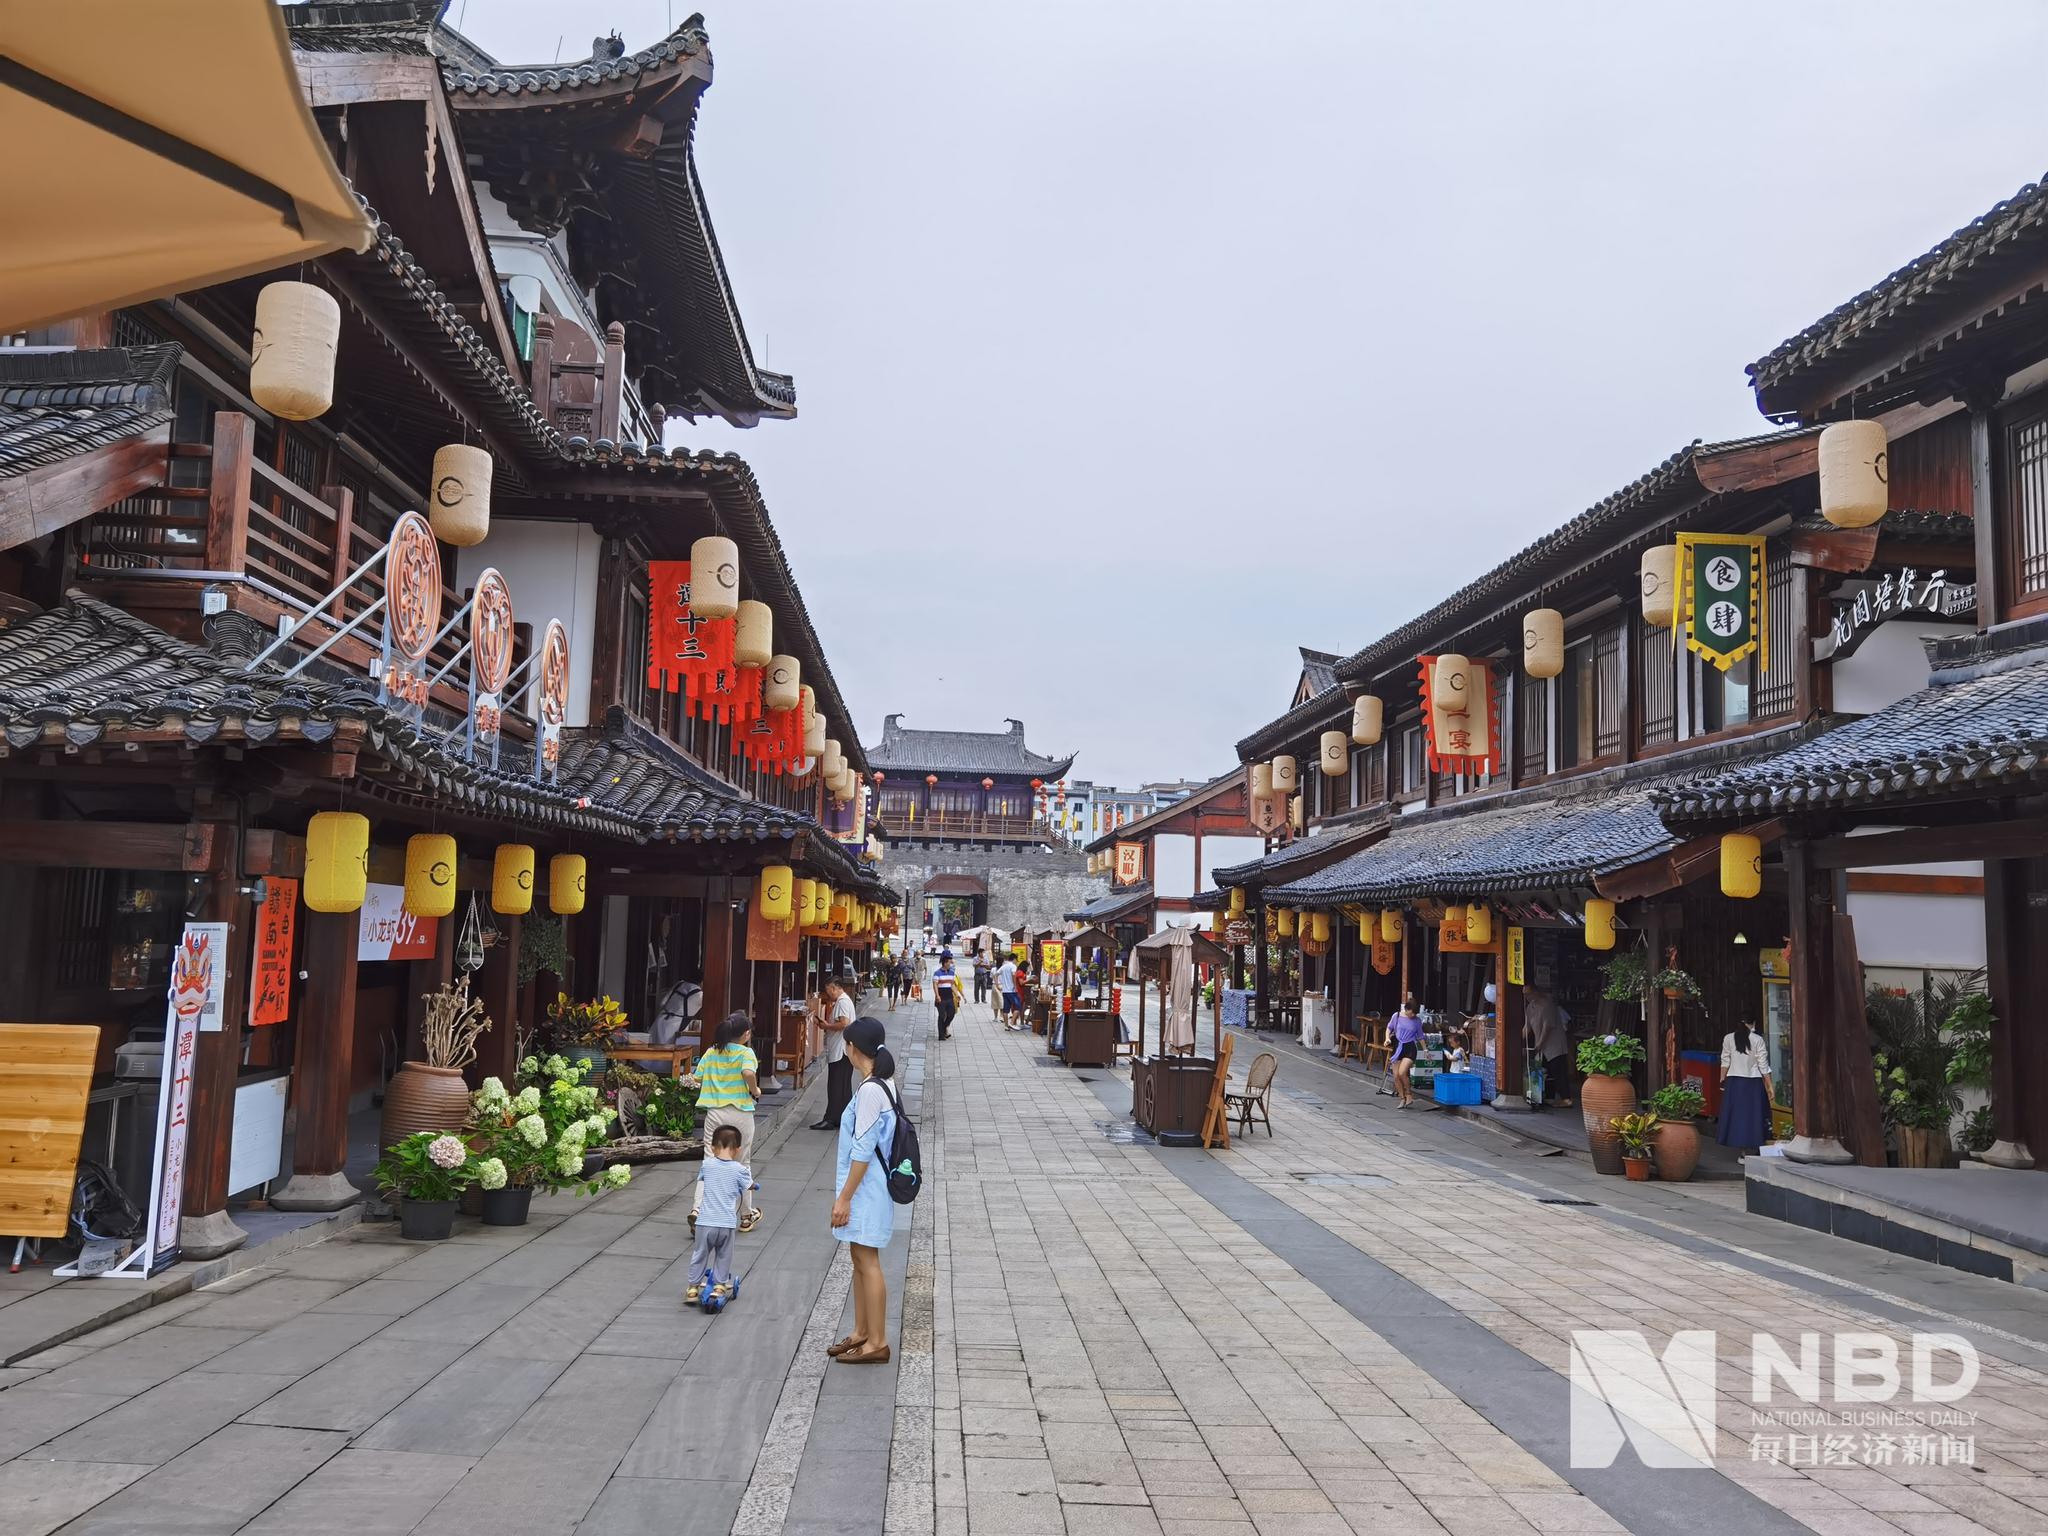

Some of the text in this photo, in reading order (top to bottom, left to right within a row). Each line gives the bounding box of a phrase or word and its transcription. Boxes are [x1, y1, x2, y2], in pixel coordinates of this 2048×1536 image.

[1710, 558, 1738, 634] 食肆
[1122, 848, 1136, 875] 汉服
[367, 917, 396, 943] 小龙虾
